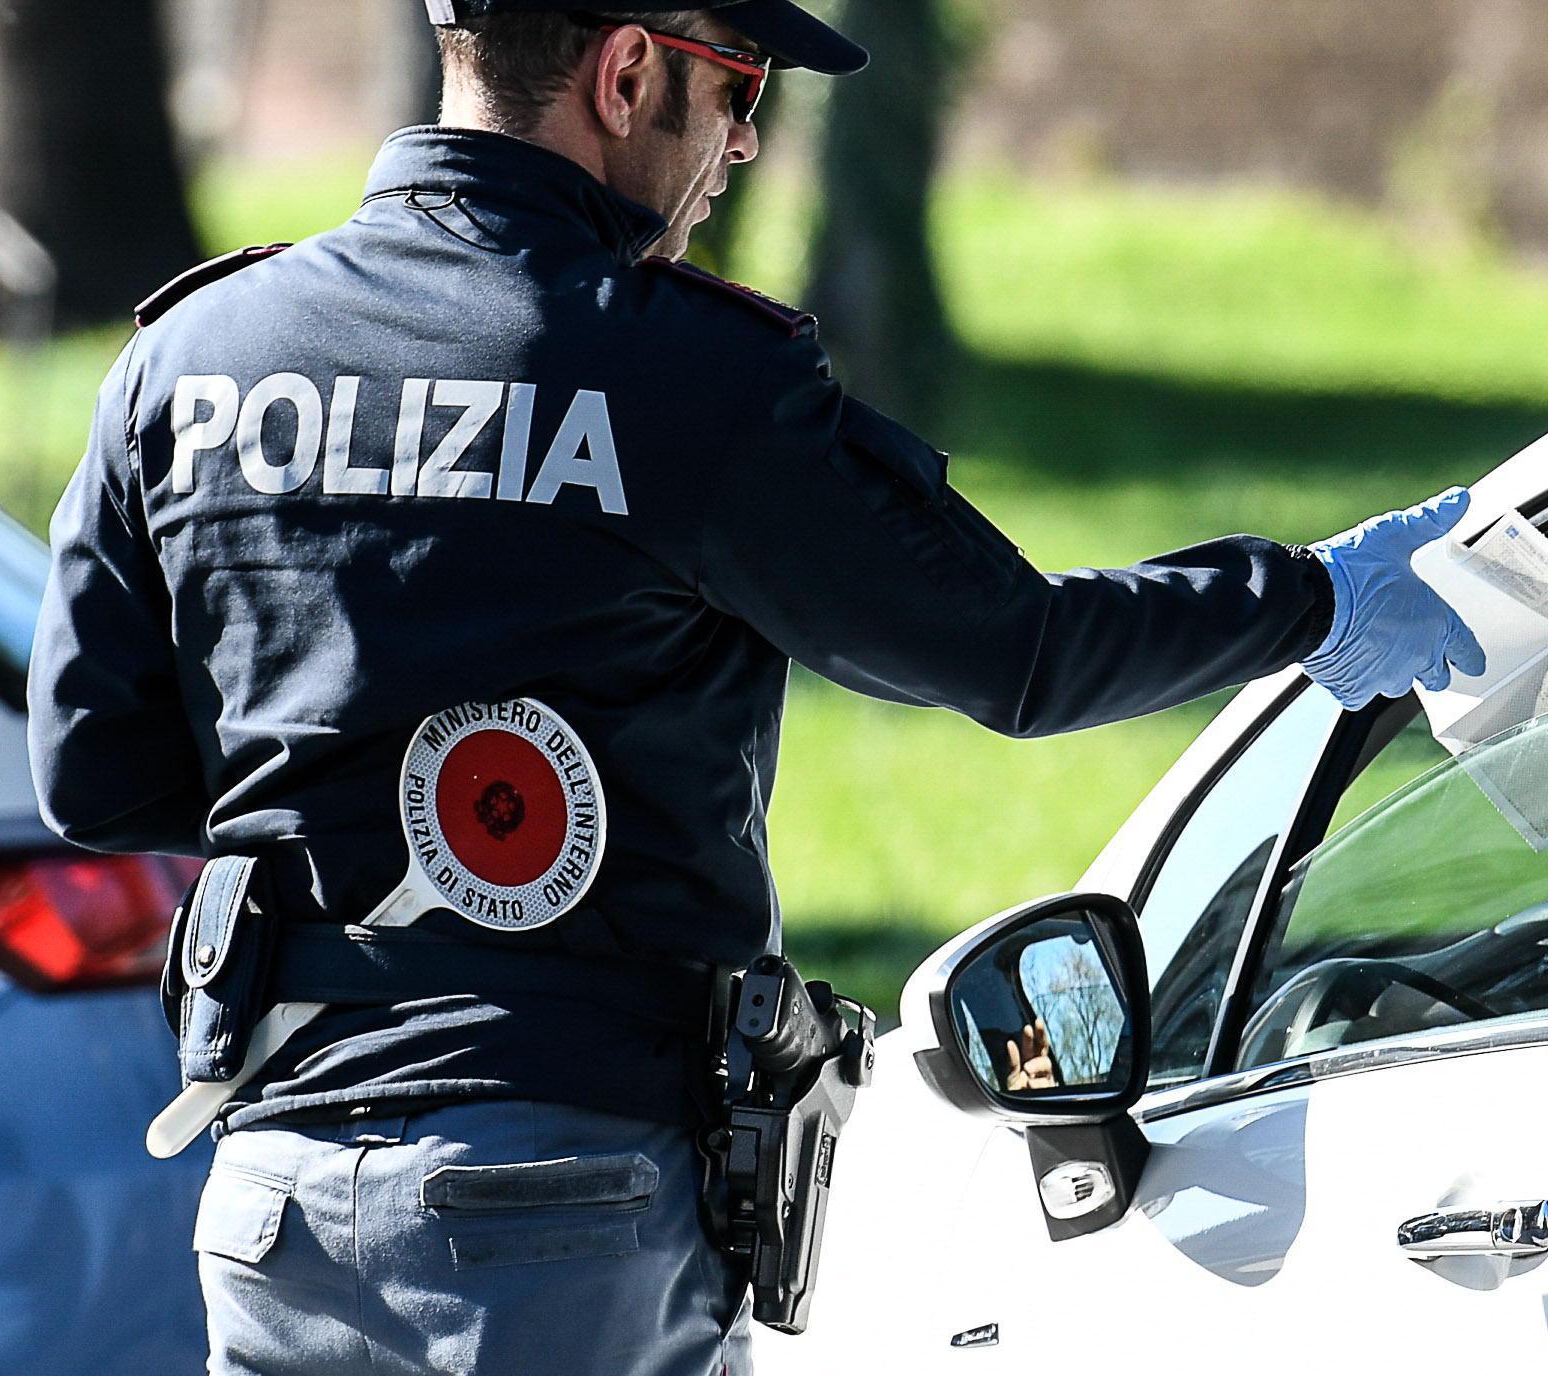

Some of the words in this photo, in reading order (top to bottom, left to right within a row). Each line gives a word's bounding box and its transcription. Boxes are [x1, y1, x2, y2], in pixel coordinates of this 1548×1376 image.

[171, 371, 630, 516] POLIZIA
[421, 700, 541, 753] MINISTERO
[406, 773, 439, 865] POLIZIA
[436, 866, 460, 891] DI
[461, 887, 524, 921] STATO
